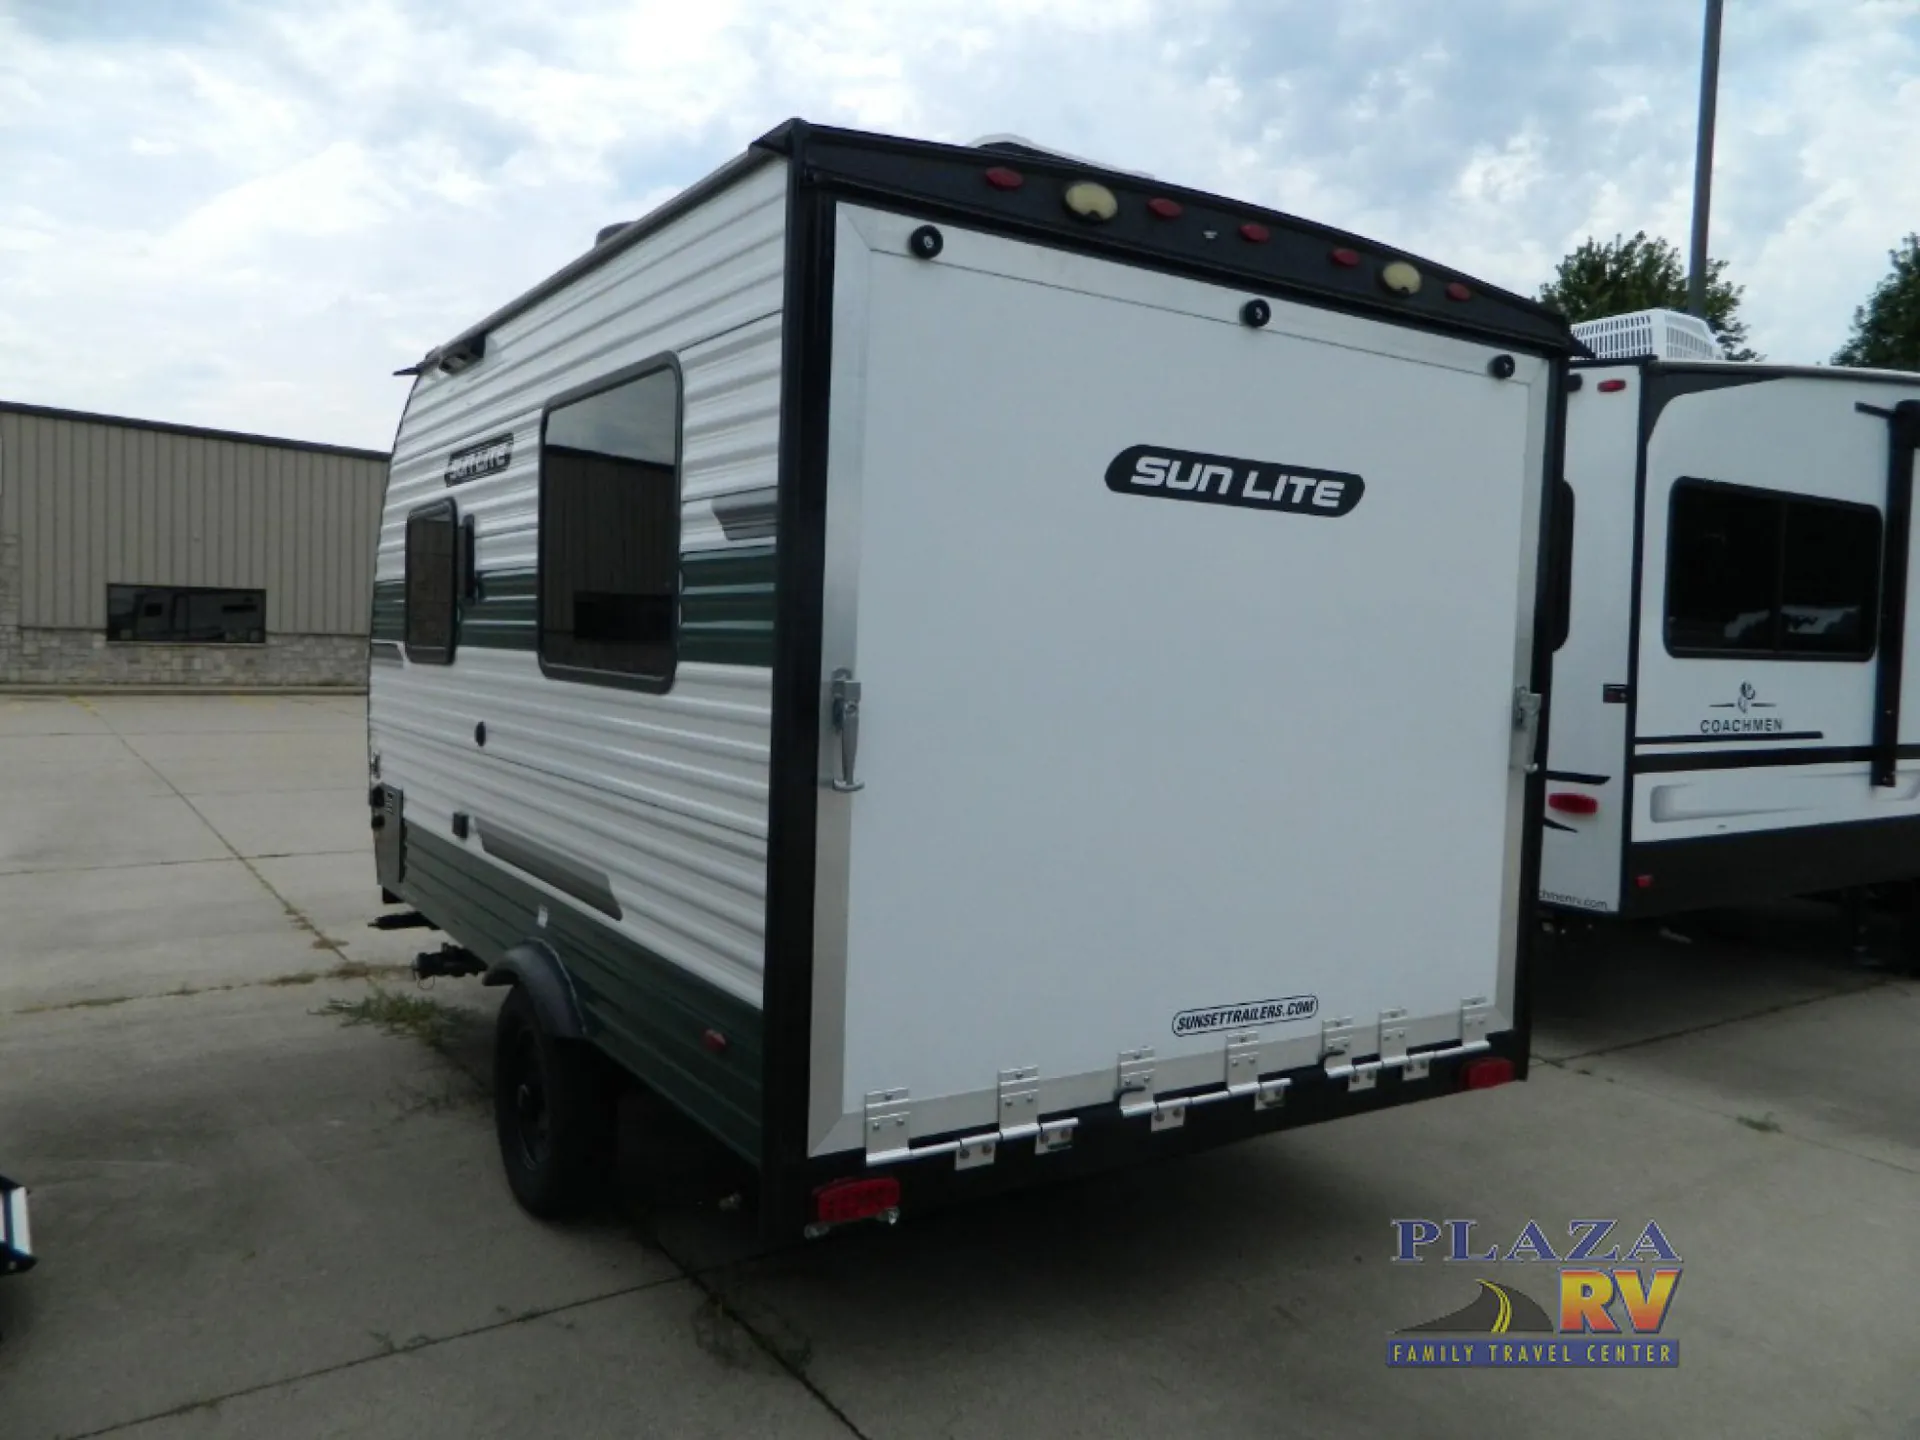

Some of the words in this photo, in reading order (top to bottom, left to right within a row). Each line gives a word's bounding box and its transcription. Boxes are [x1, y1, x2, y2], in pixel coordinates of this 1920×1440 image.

[1130, 456, 1234, 494] SUN
[1242, 471, 1344, 508] LITE
[1700, 718, 1783, 733] COACHMEN
[1176, 1000, 1315, 1031] SUNSETTRAILERS.COM
